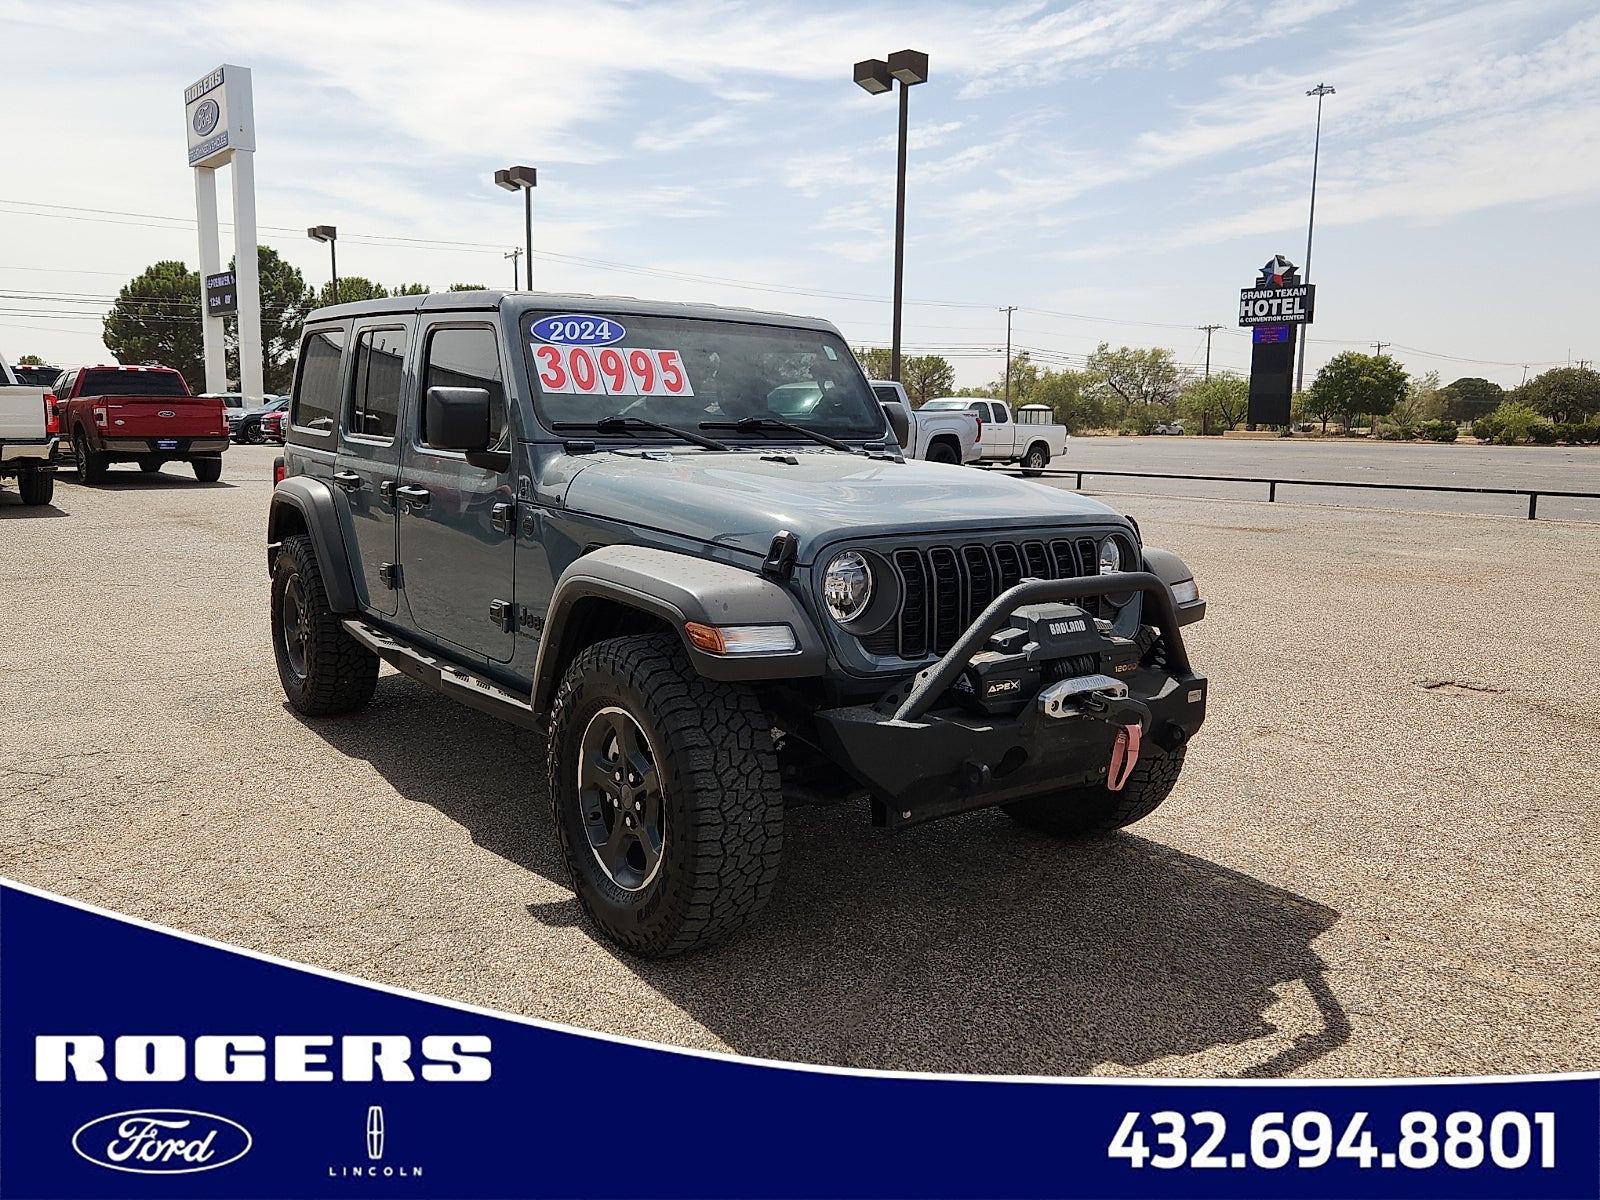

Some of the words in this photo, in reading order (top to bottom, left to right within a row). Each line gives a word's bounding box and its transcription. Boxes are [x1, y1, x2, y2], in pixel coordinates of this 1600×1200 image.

[185, 70, 221, 104] ROGERS
[1241, 290, 1274, 300] GRAND
[1275, 287, 1307, 298] TEXAN
[1240, 297, 1305, 317] HOTEL
[1245, 315, 1281, 323] CONVENTION
[1282, 314, 1305, 322] CENTER
[549, 320, 612, 342] 2024
[536, 346, 685, 393] 30995
[1049, 619, 1087, 636] BADLAND
[987, 680, 1019, 694] APEX
